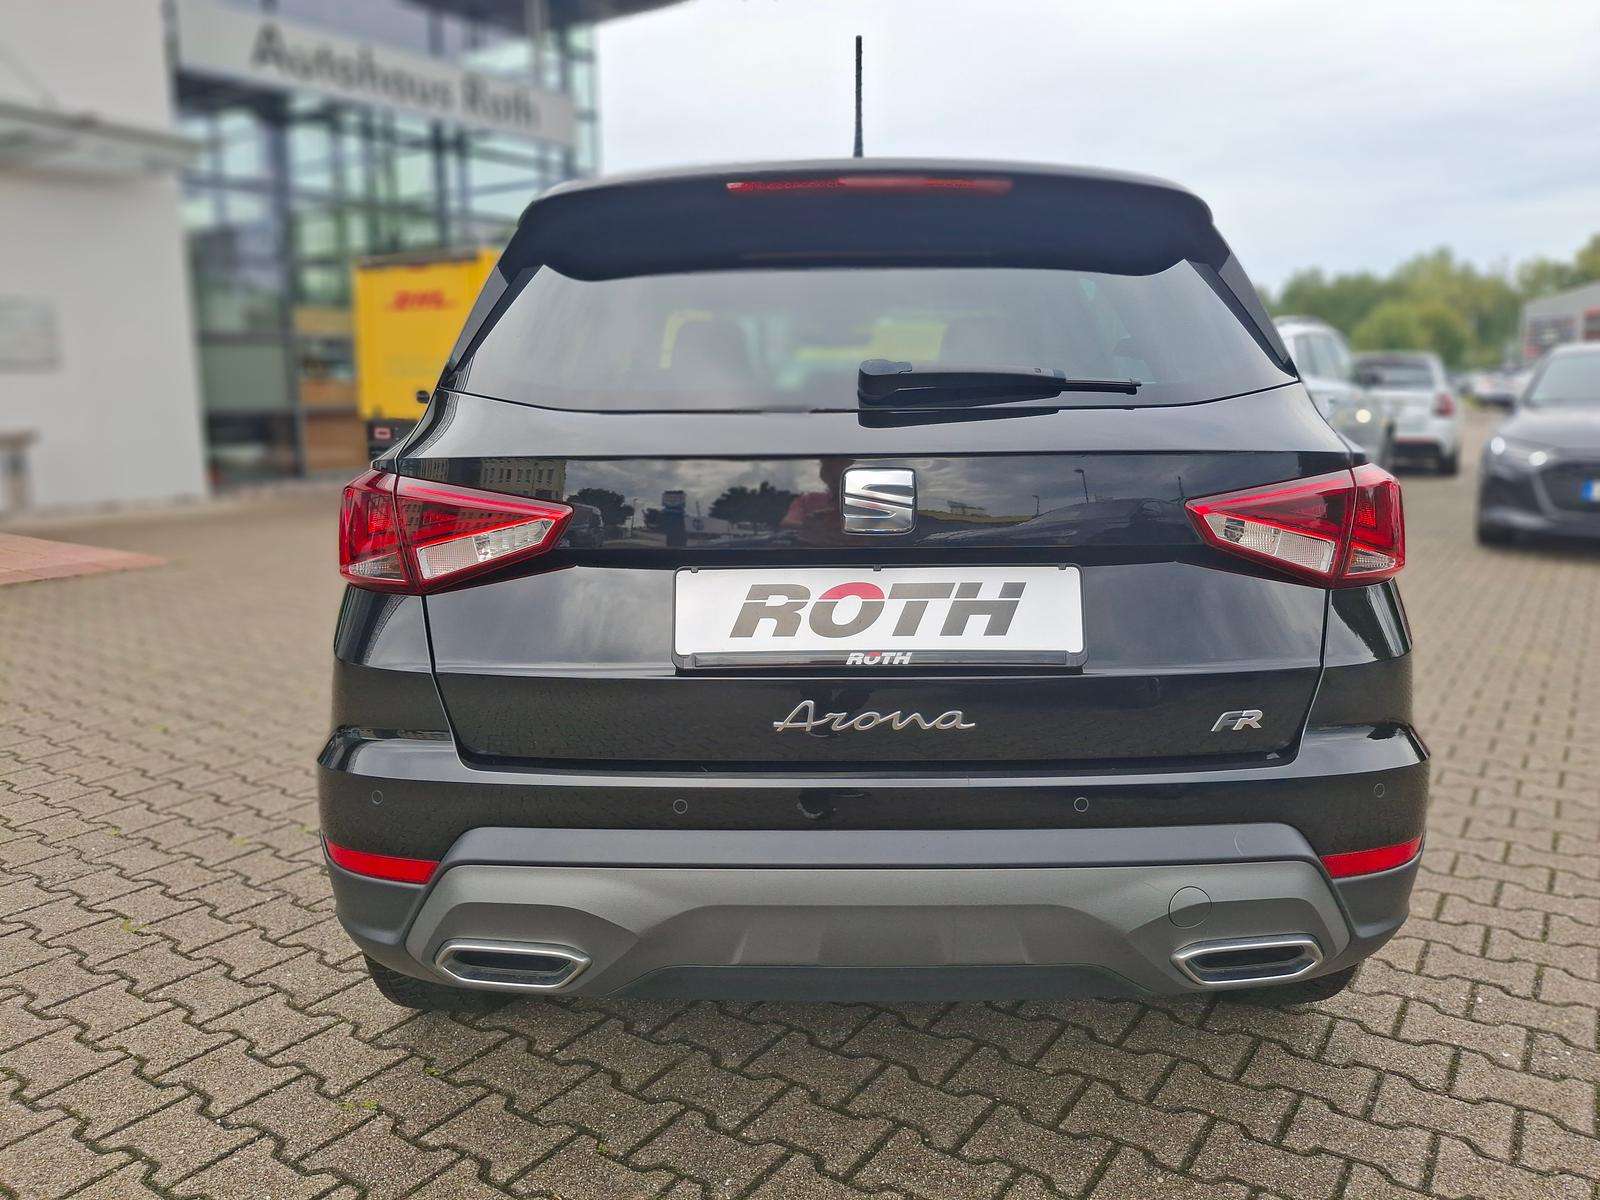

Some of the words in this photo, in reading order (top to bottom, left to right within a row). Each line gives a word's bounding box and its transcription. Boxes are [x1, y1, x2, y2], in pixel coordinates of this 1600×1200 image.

[253, 23, 455, 109] Autohaus
[462, 72, 535, 126] Roth
[730, 581, 1027, 639] ROTH
[845, 651, 913, 665] ROTH
[773, 700, 976, 732] Arona
[1211, 709, 1263, 732] FR
